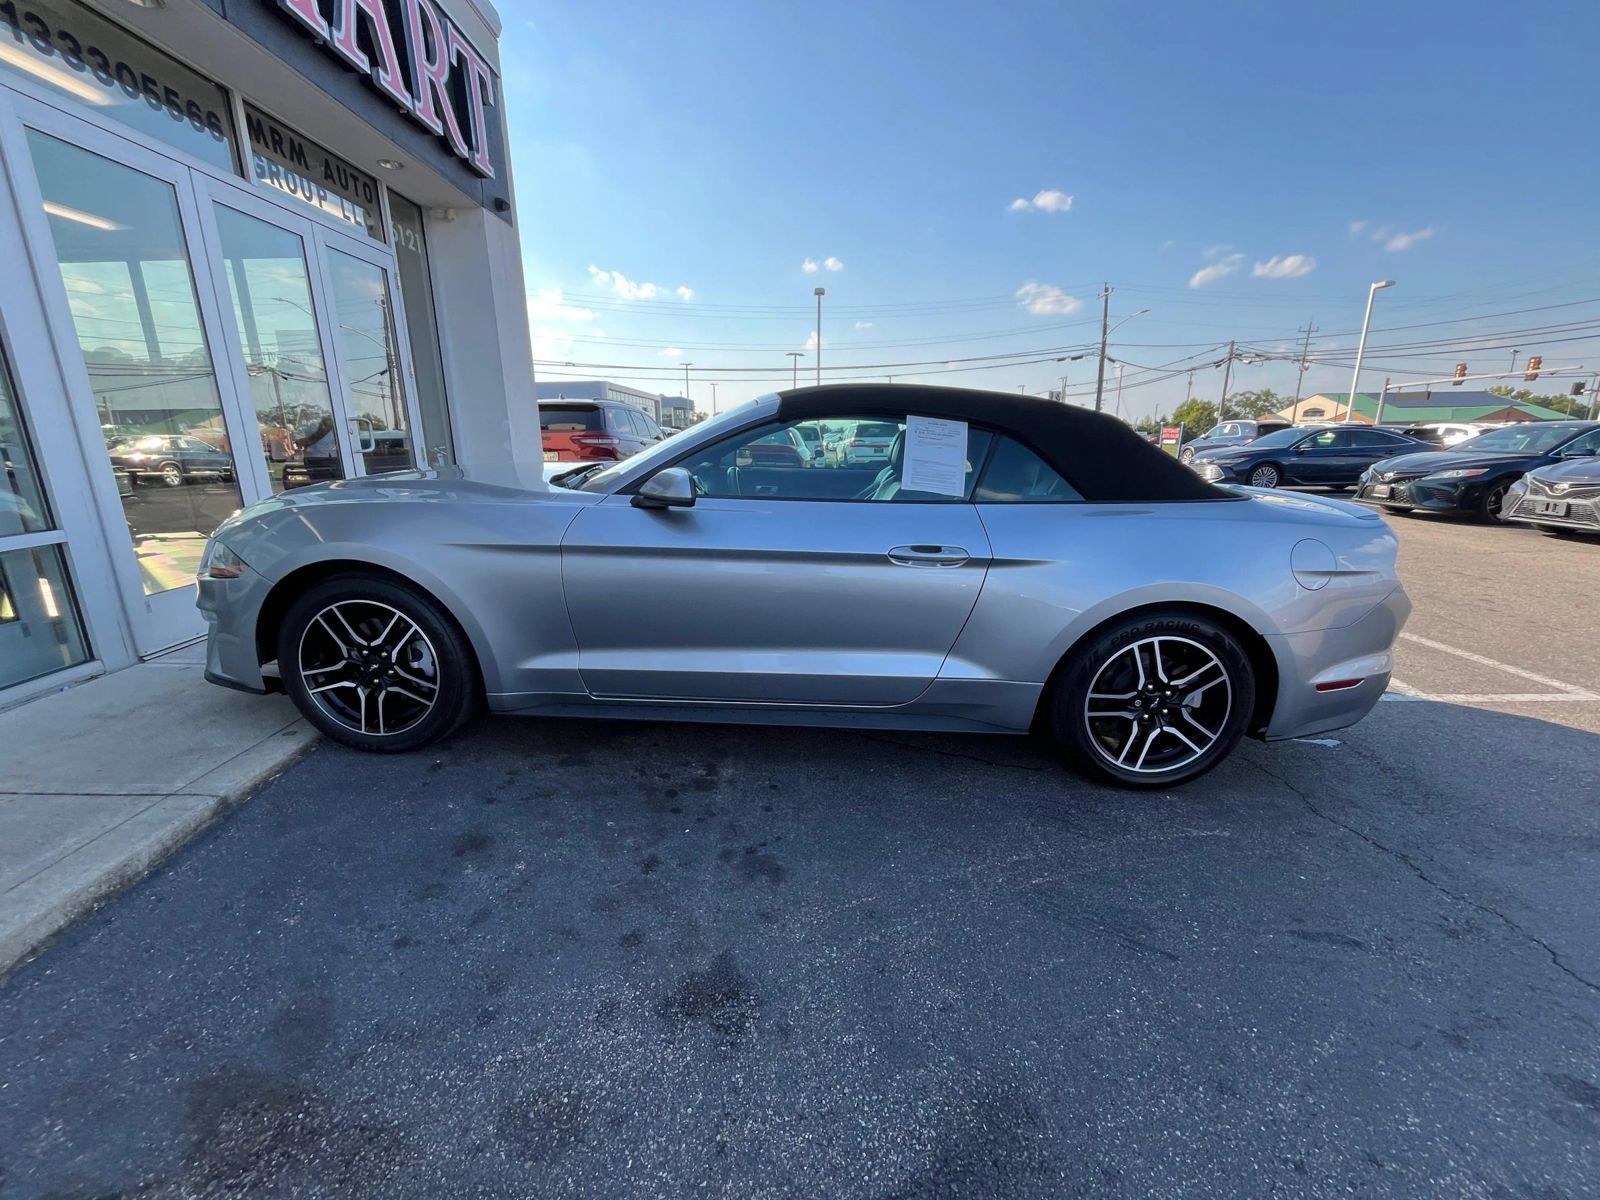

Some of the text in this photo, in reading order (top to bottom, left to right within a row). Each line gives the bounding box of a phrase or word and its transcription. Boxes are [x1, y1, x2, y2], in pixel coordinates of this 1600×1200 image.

[279, 0, 495, 179] ART
[245, 112, 374, 204] MRM AUTO
[253, 155, 374, 231] GROUP LLC
[1144, 620, 1202, 633] RACING
